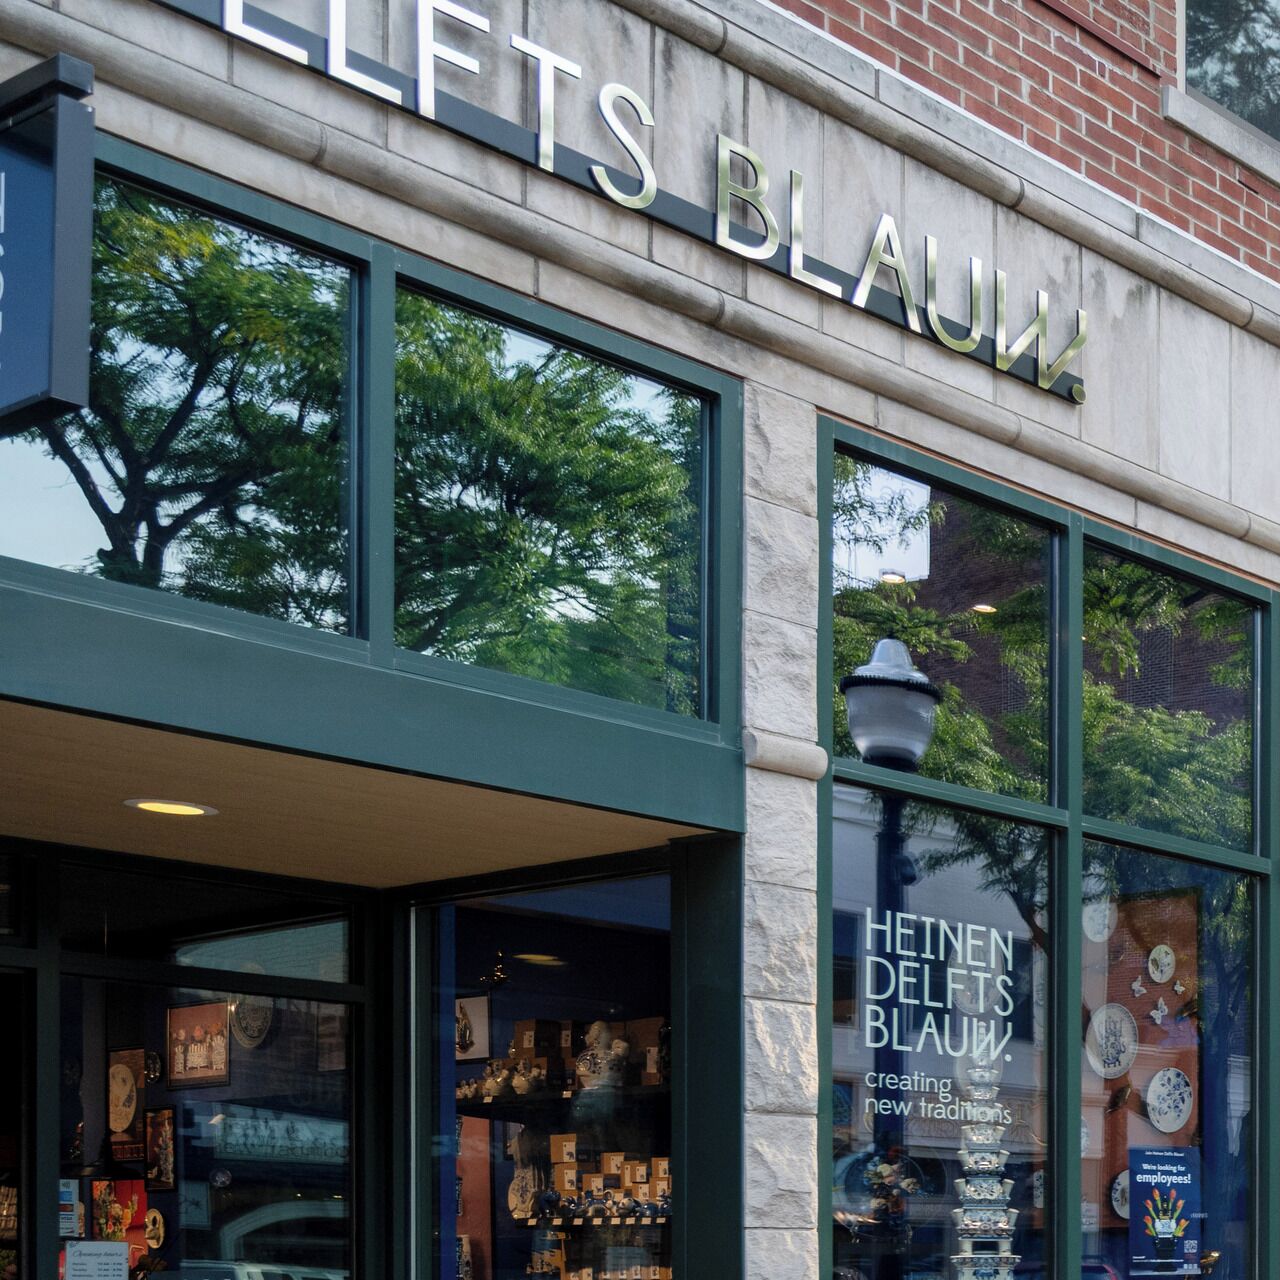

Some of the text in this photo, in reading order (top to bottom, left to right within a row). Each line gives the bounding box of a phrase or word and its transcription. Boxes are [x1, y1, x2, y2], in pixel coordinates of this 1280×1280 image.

[715, 133, 1088, 405] BLAUW.
[866, 907, 1013, 971] HEINEN
[866, 955, 1014, 1017] DELFTS
[865, 1004, 1013, 1063] BLAUW.
[865, 1071, 953, 1103] creating
[865, 1096, 1013, 1125] new traditions
[1136, 1172, 1191, 1187] employees!
[1157, 1163, 1177, 1173] looking
